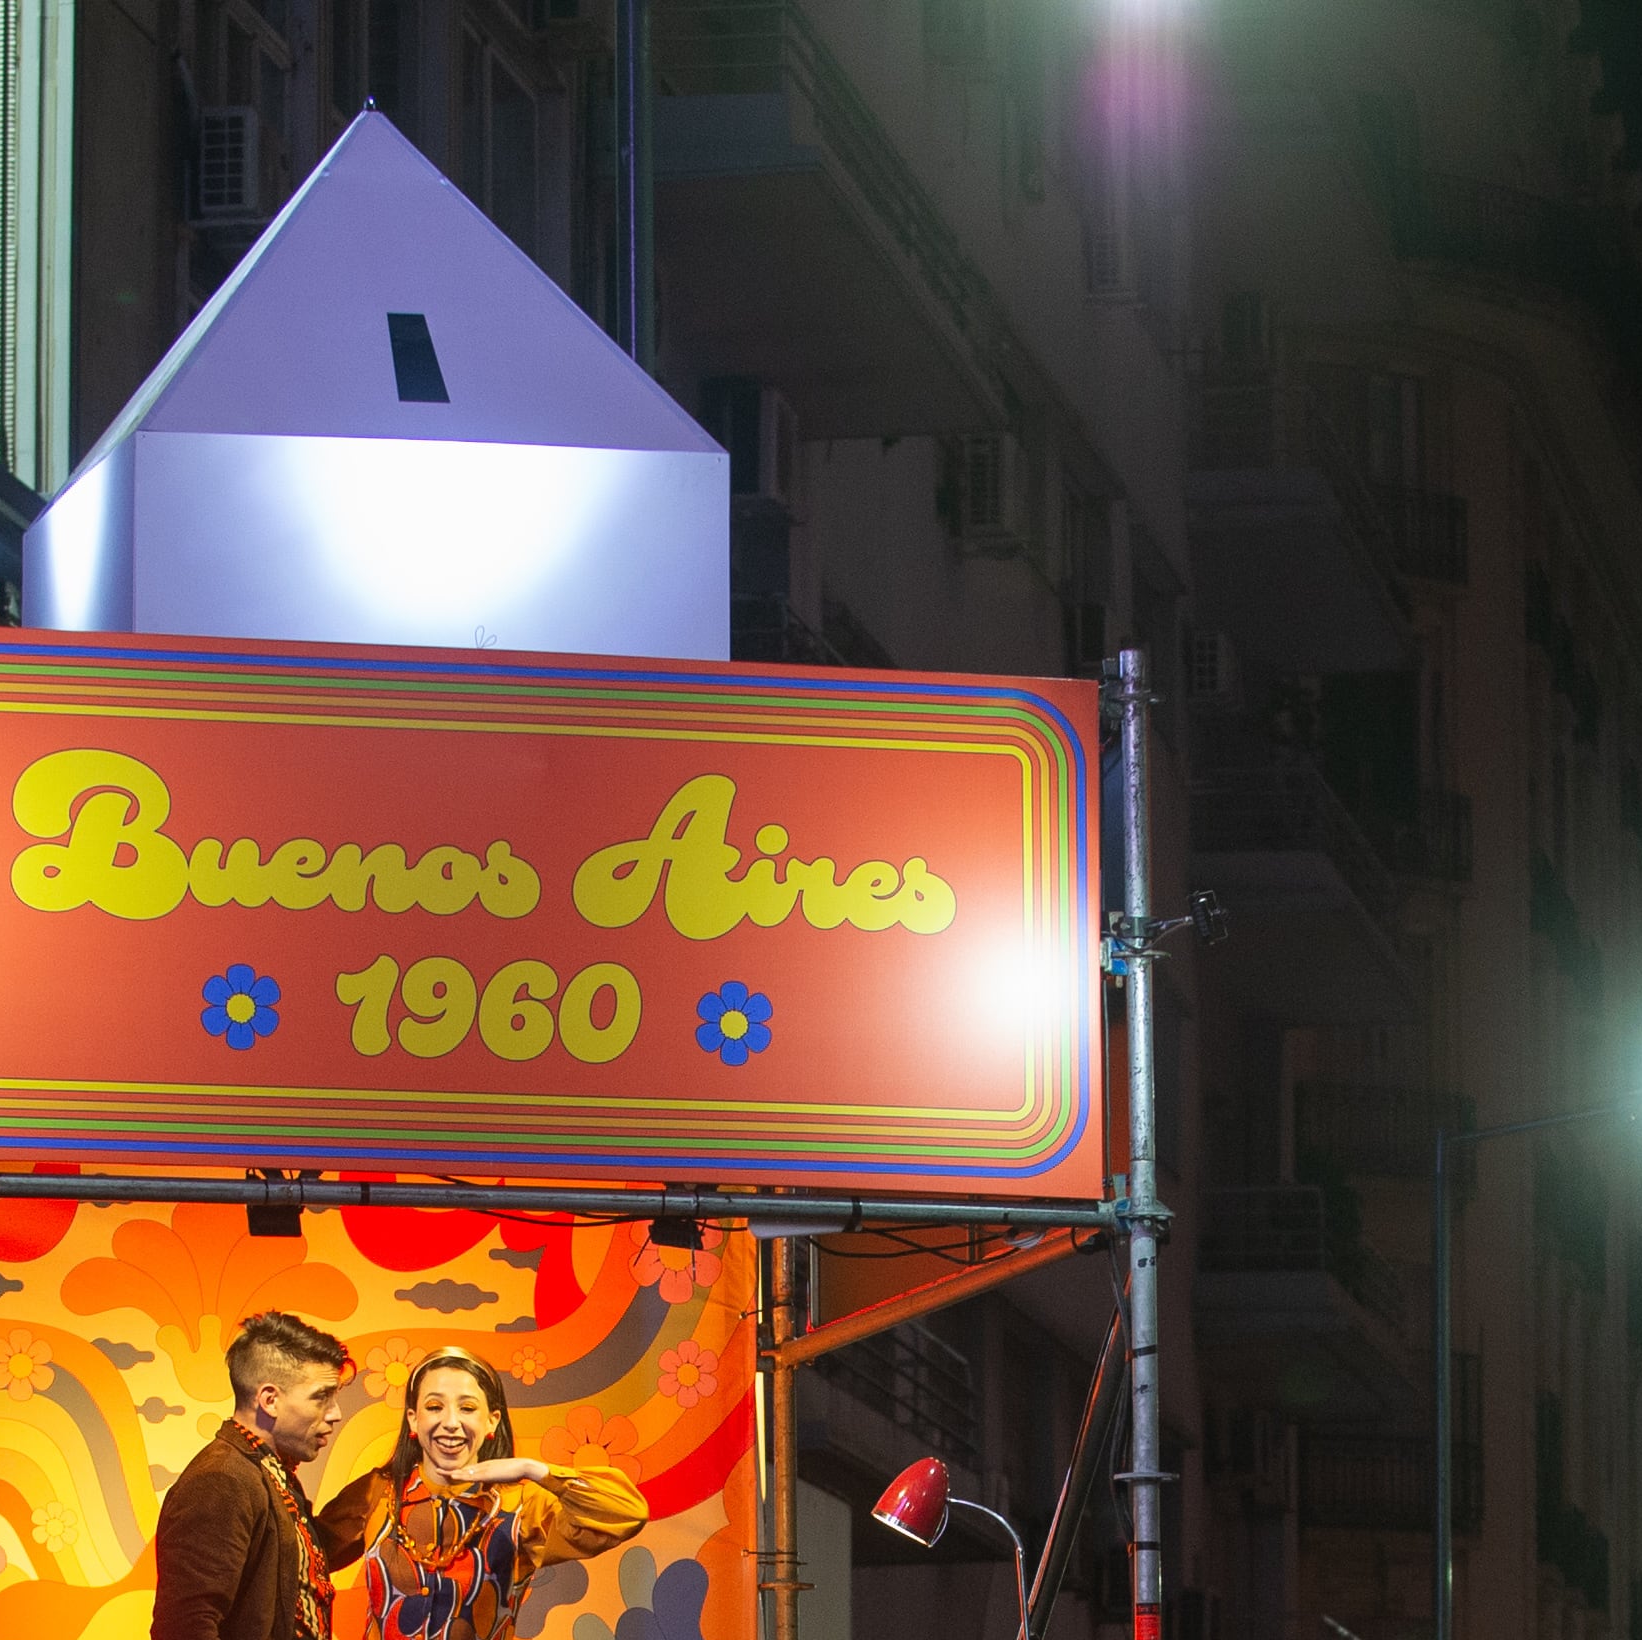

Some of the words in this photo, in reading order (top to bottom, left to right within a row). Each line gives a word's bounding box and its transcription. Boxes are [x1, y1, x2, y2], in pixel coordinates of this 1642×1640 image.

[9, 747, 542, 921] Buenos
[572, 772, 958, 940] Aires
[334, 954, 642, 1064] 1960
